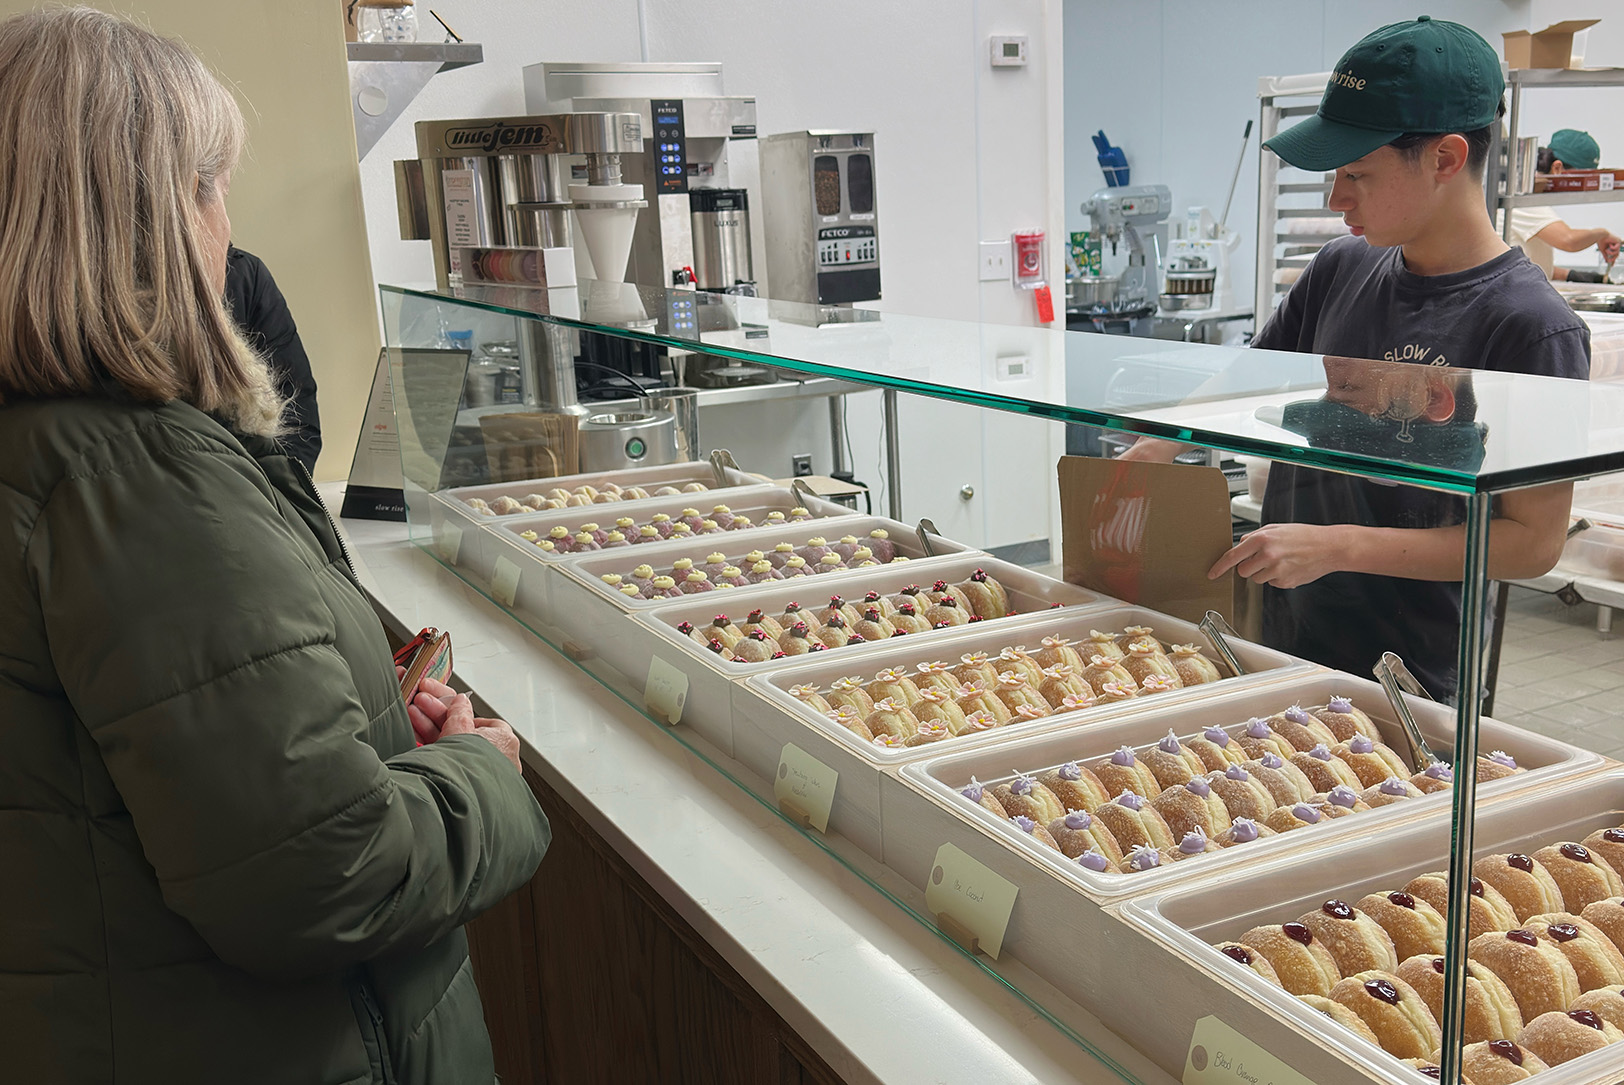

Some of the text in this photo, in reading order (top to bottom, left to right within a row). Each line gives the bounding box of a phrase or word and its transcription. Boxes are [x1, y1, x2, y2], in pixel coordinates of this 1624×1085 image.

[821, 228, 849, 238] FETCO
[1383, 343, 1431, 362] SLOW
[375, 503, 404, 513] slow rise
